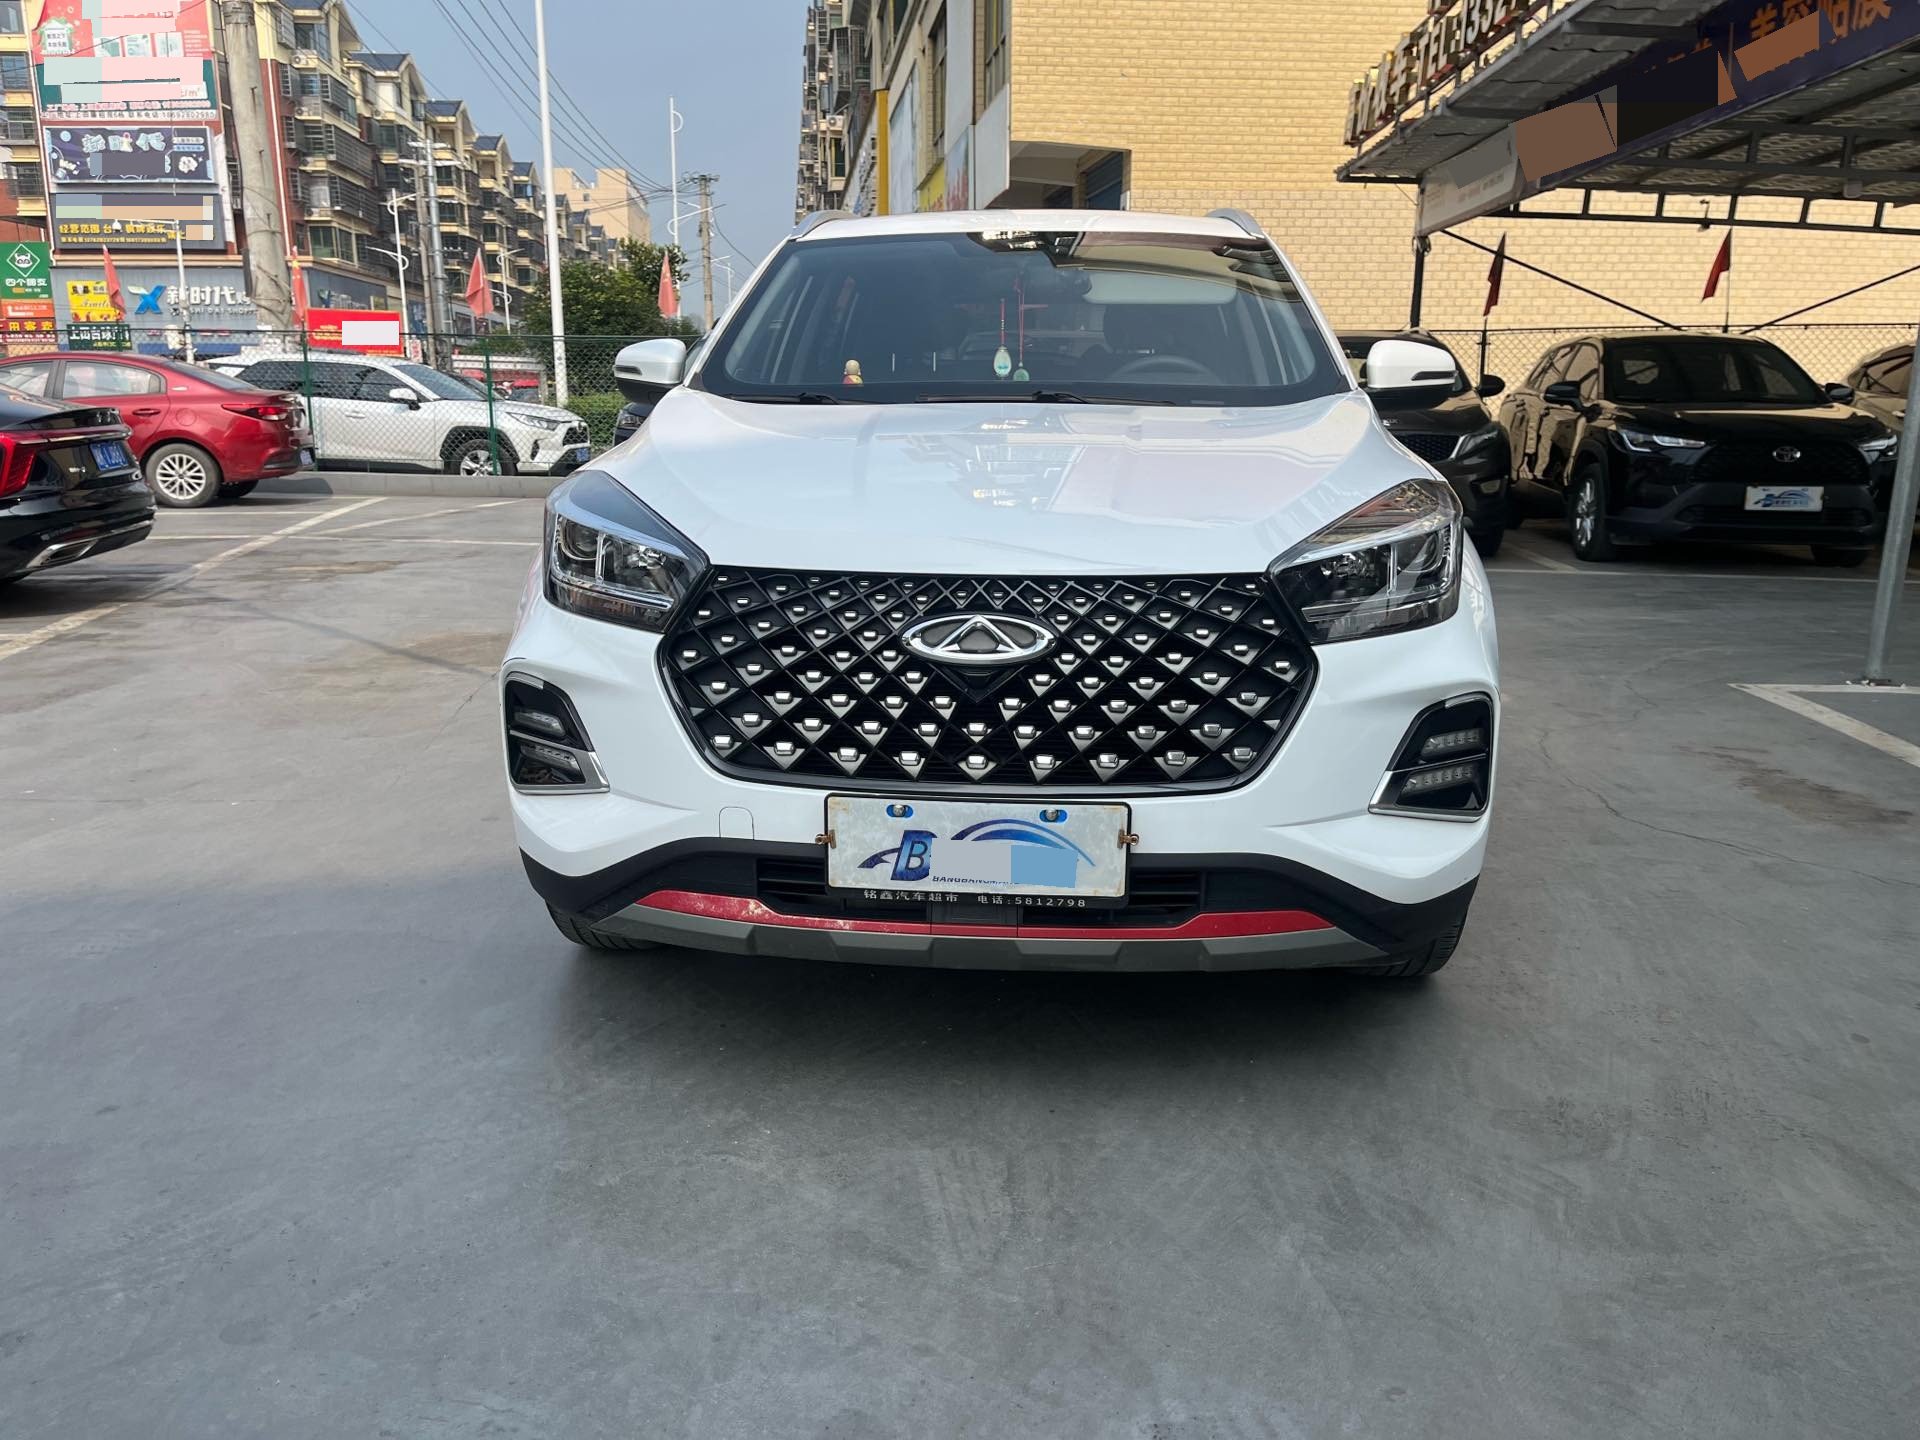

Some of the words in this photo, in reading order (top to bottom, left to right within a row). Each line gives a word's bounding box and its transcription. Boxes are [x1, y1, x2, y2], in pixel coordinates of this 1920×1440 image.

[863, 889, 959, 902] 铭鑫汽车超市
[977, 895, 1086, 907] 电话:5812798
